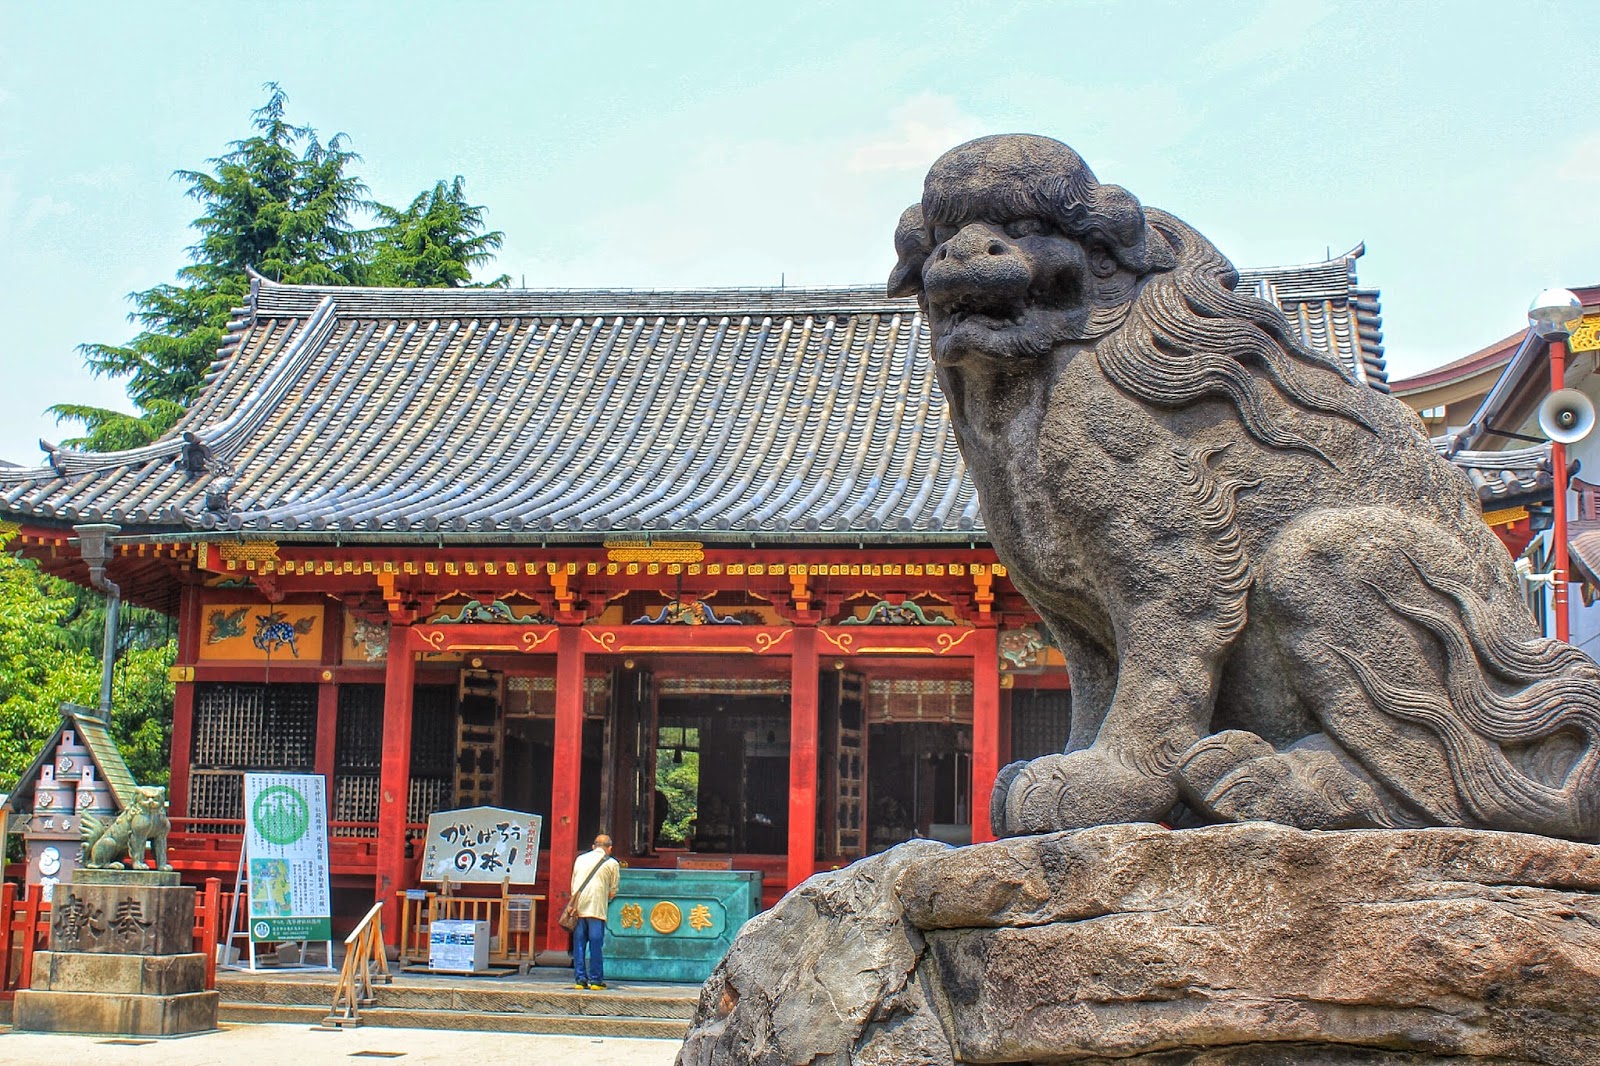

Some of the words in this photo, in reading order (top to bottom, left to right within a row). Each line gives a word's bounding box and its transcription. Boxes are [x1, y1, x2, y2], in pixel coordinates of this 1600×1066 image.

[440, 822, 521, 848] がんばろう
